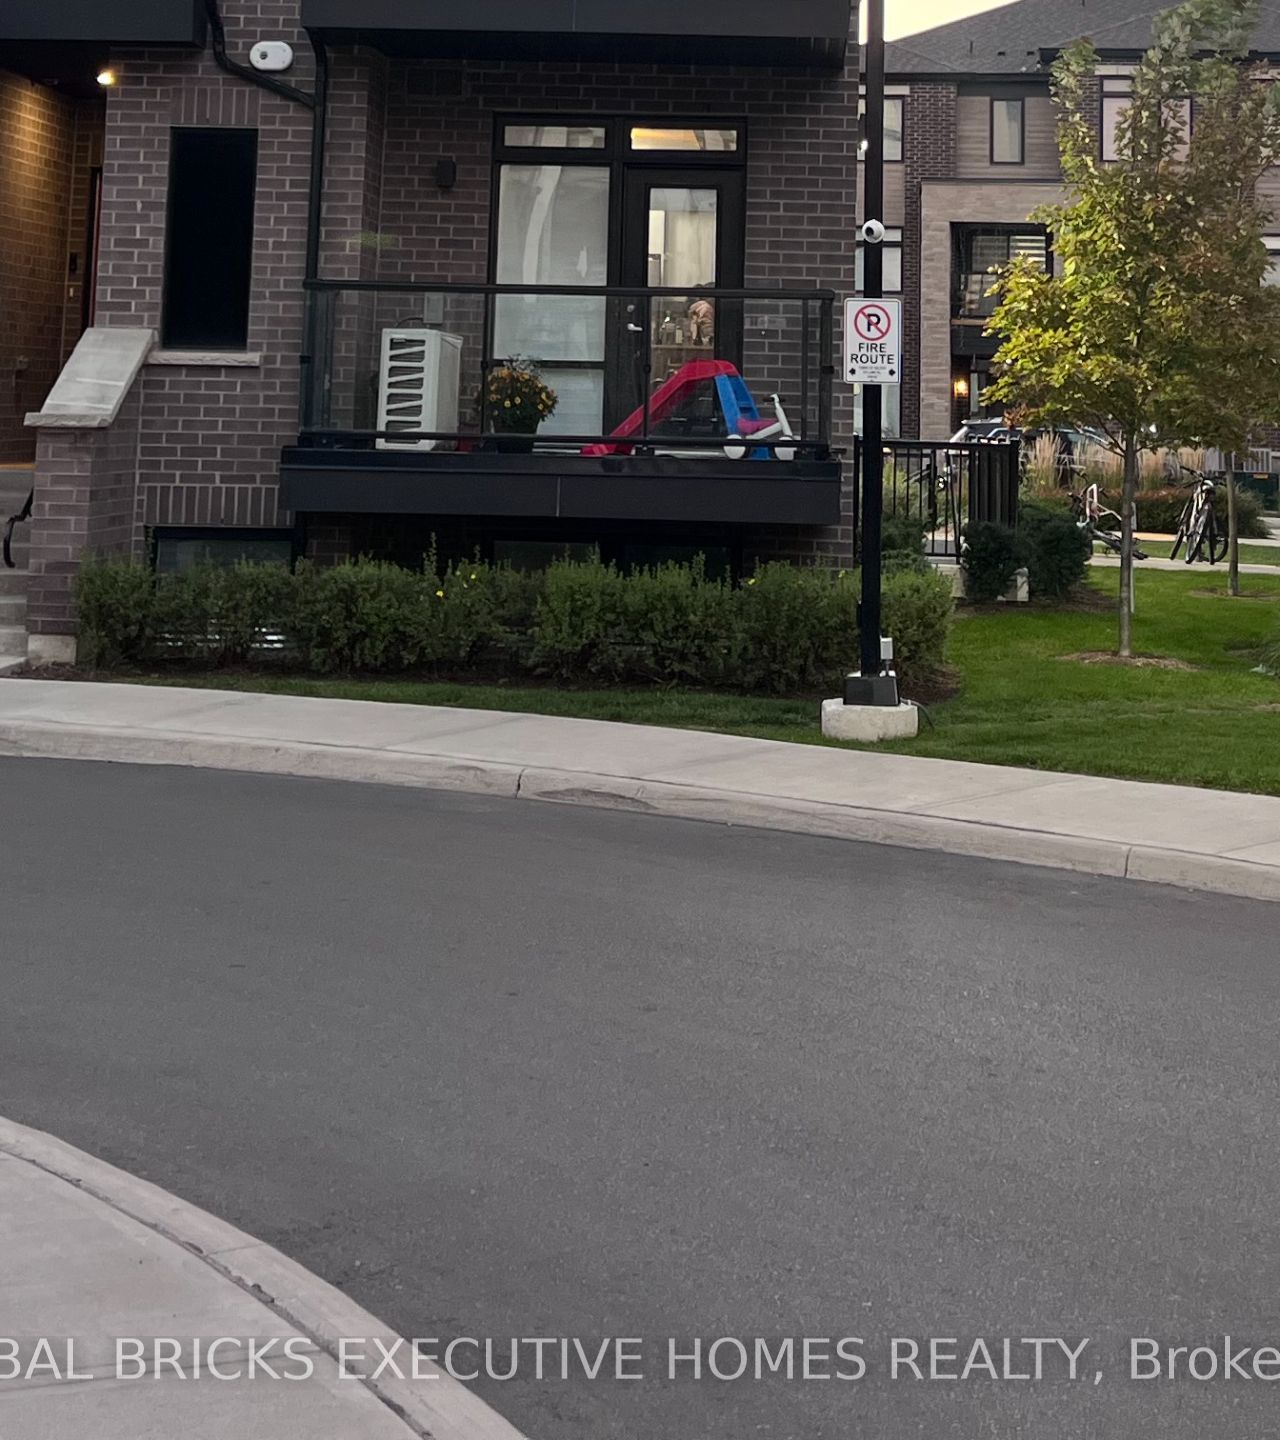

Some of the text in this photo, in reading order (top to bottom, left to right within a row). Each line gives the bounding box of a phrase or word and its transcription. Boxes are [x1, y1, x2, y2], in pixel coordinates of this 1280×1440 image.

[867, 313, 881, 332] P
[858, 342, 887, 353] FIRE
[850, 353, 895, 365] ROUTE
